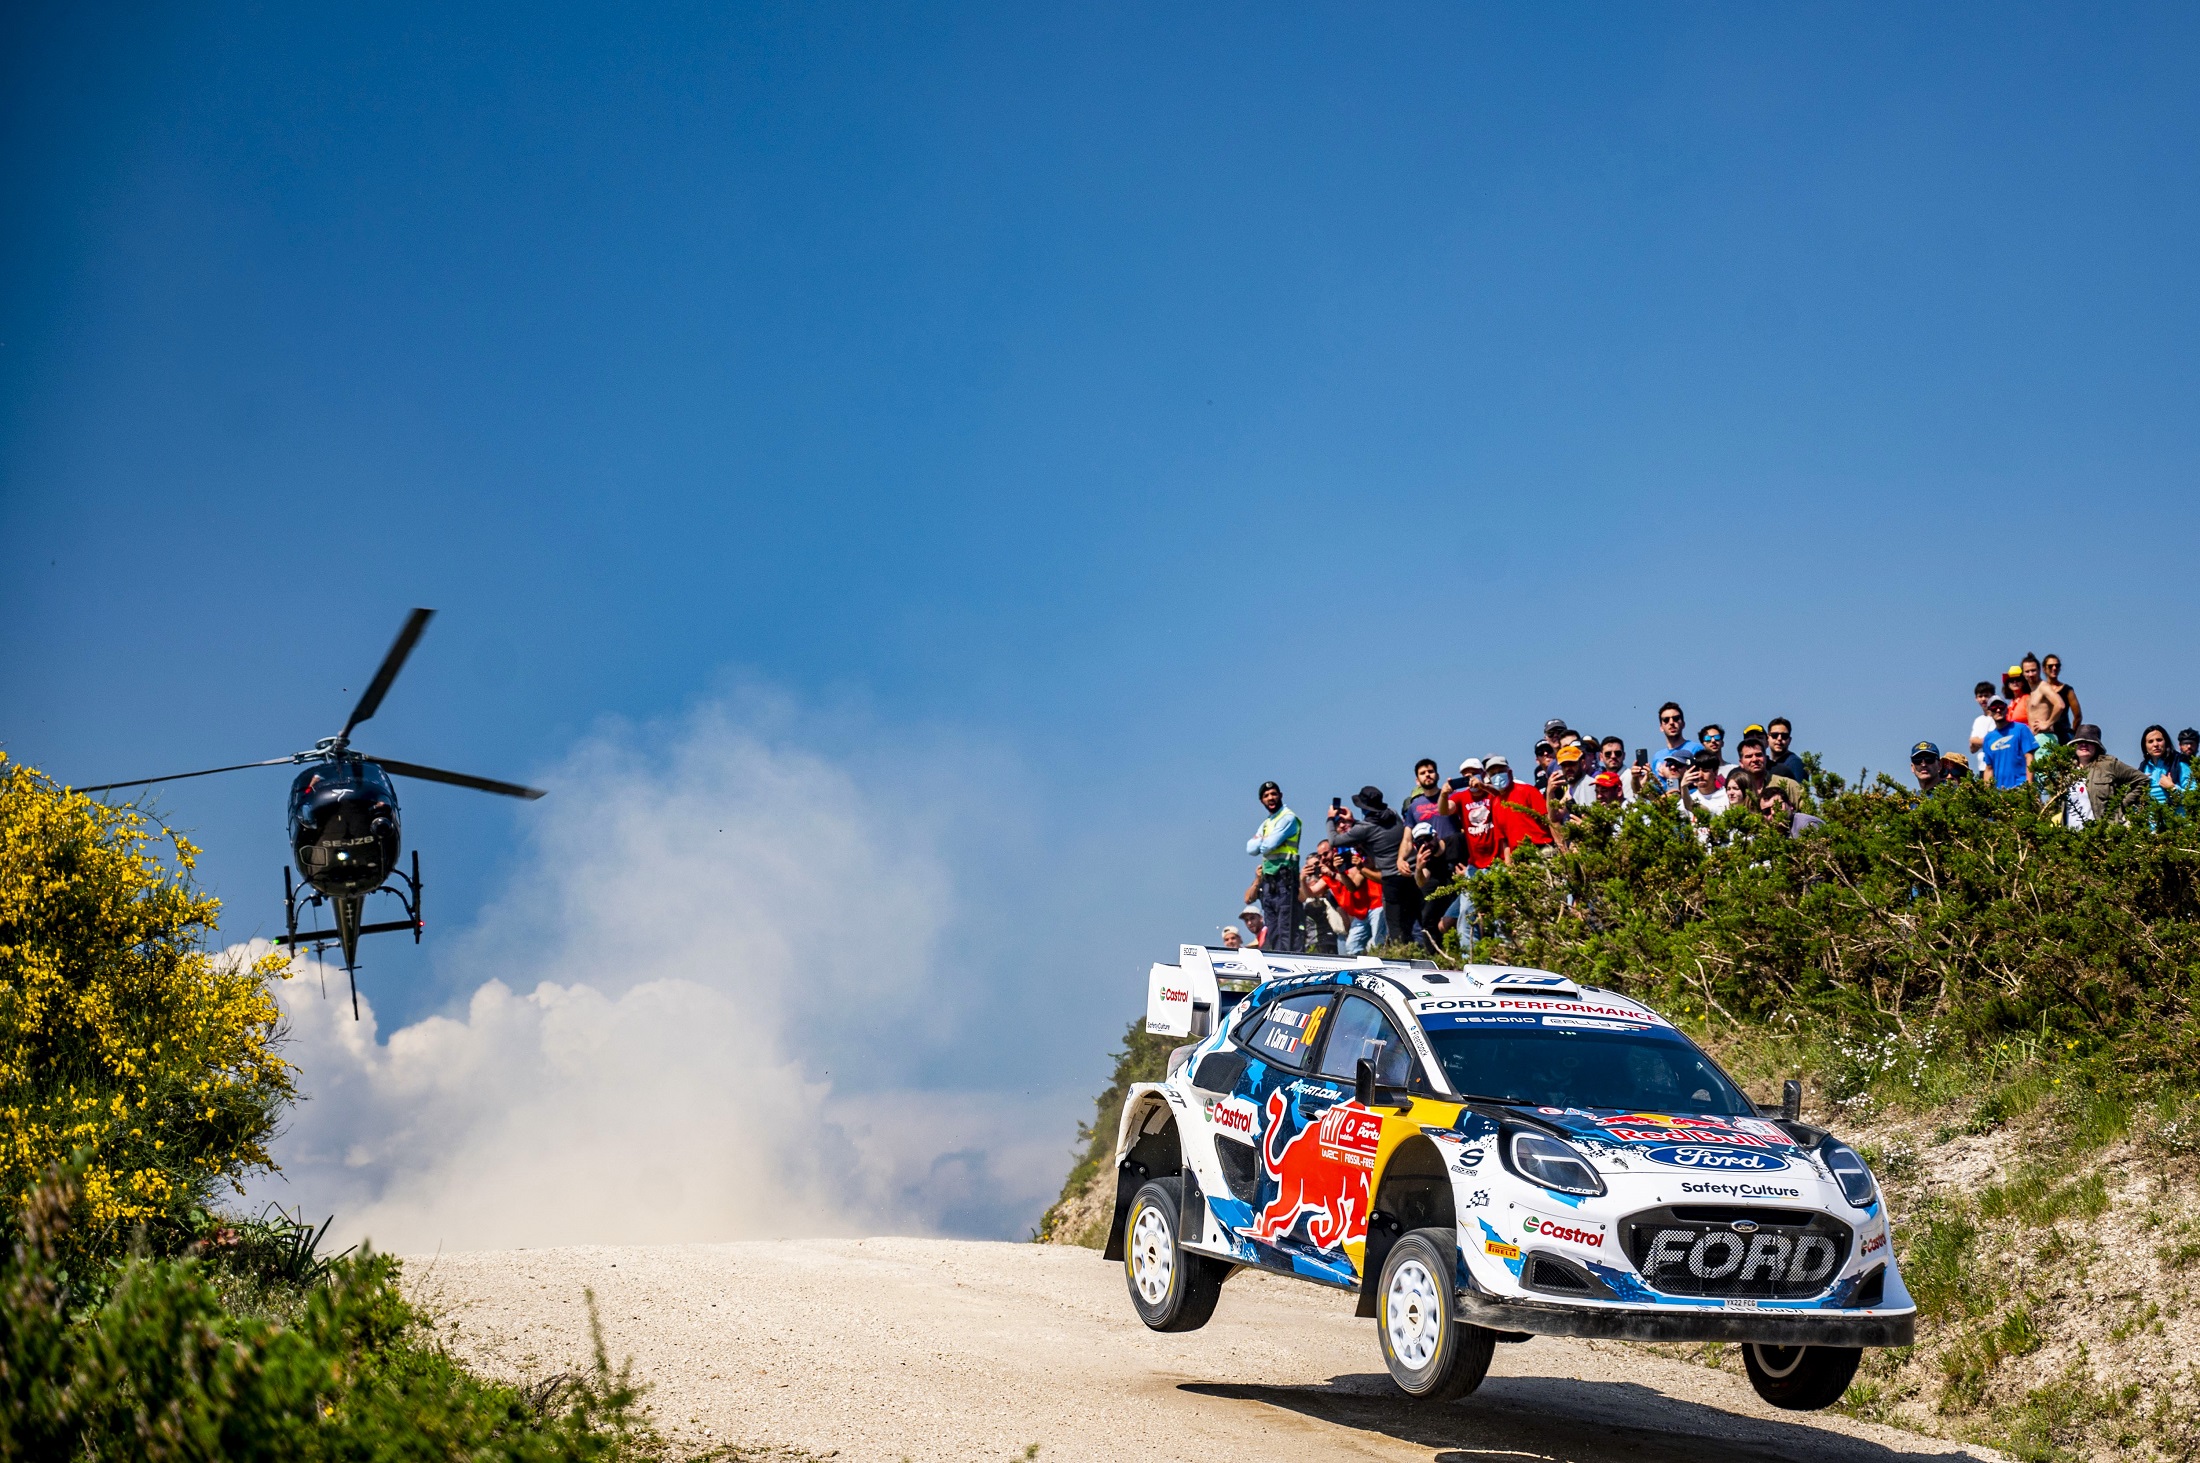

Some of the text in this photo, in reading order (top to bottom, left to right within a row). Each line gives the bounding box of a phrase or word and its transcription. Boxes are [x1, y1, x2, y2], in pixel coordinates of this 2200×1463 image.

[1166, 988, 1188, 1003] Castrol
[1420, 1001, 1659, 1023] FORD PERFORMANCE
[1301, 1005, 1328, 1046] 16
[1550, 1019, 1611, 1027] RALLY
[1213, 1102, 1253, 1133] Castrol
[1609, 1128, 1696, 1142] Red
[1687, 1129, 1770, 1148] Bull
[1344, 1153, 1375, 1168] FOSSIL-FREE
[1674, 1148, 1766, 1168] Ford
[1558, 1184, 1601, 1196] LAZER
[1681, 1182, 1799, 1197] SafetyCulture
[1540, 1220, 1605, 1247] Castrol
[1488, 1243, 1517, 1257] PIRELLI
[1641, 1229, 1836, 1282] FORD
